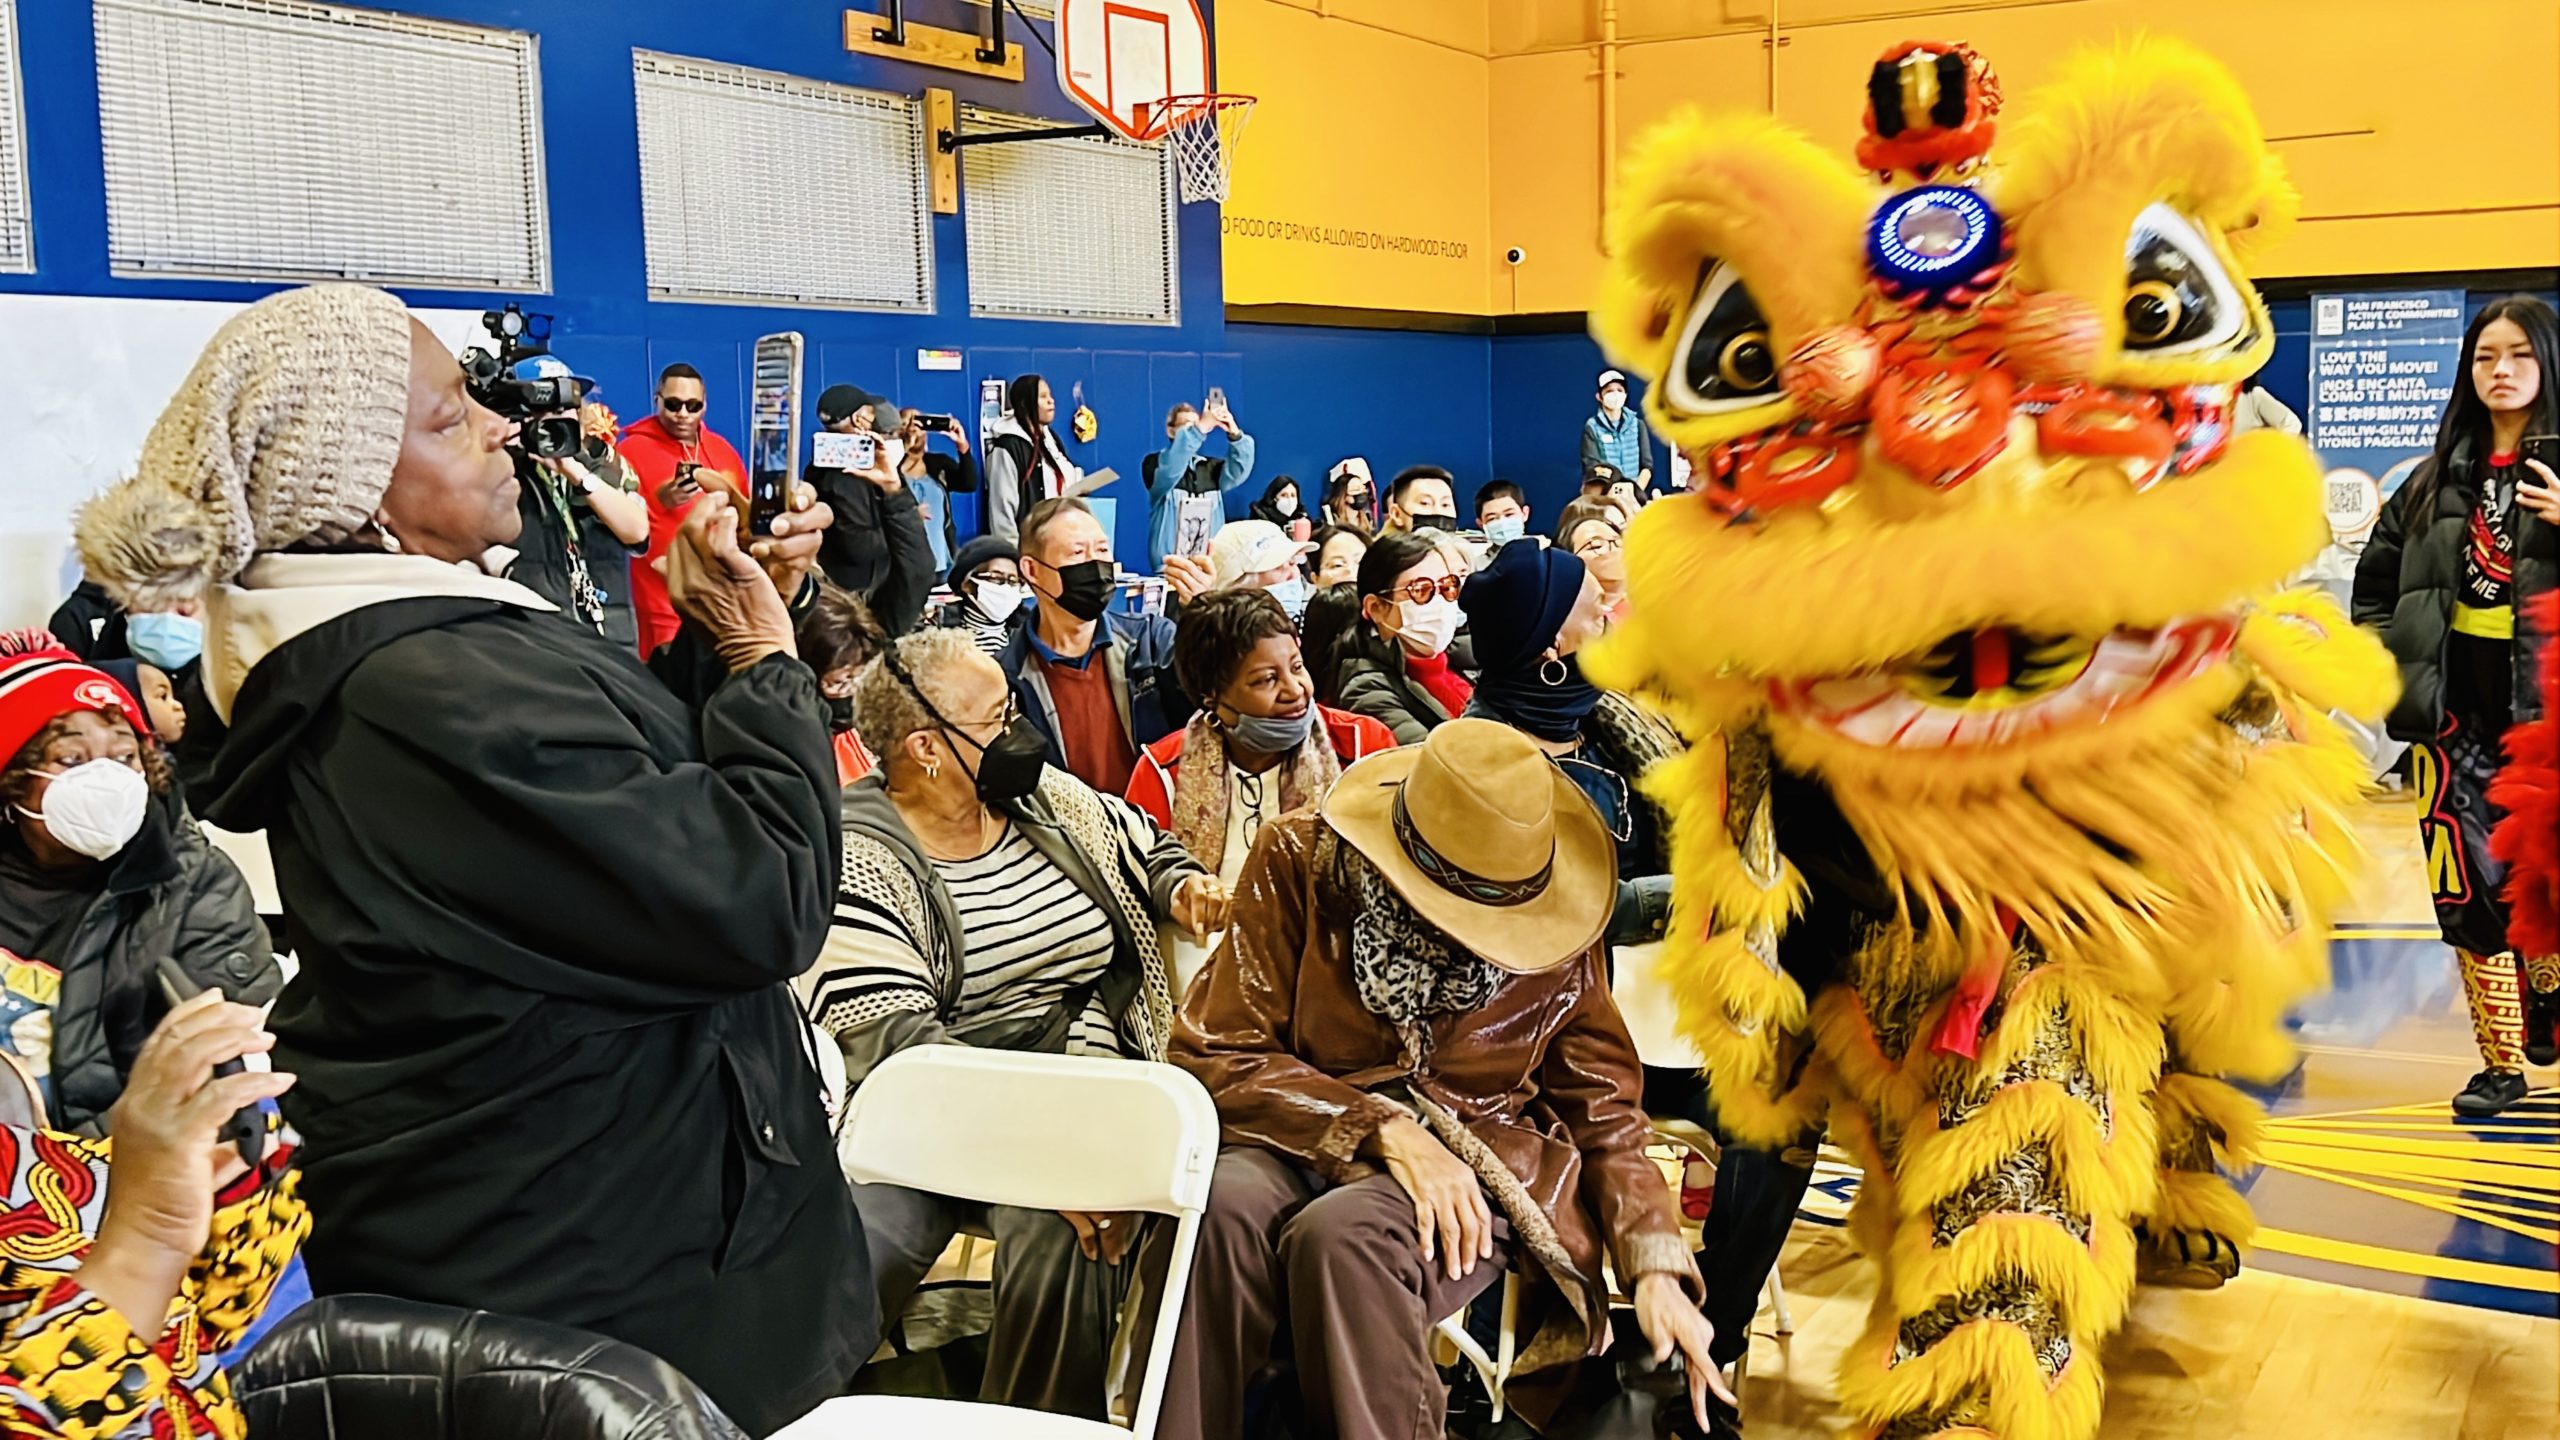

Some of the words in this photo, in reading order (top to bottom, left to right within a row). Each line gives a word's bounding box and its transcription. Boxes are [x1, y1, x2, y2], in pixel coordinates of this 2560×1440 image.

[1220, 216, 1230, 234] O
[1233, 217, 1264, 237] FOOD
[1267, 221, 1282, 239] OR
[1285, 223, 1320, 243] DRINKS
[1324, 228, 1369, 249] ALLOWED
[1370, 233, 1385, 250] ON
[1387, 235, 1439, 255] HARDWOOD
[1441, 241, 1468, 259] FLOOR
[2347, 301, 2370, 312] SAN
[2370, 299, 2430, 310] FRANCISCO
[2347, 311, 2384, 321] ACTIVE
[2385, 308, 2460, 320] COMMUNITIES
[2347, 321, 2374, 331] PLAN
[2319, 352, 2357, 364] LOVE
[2359, 350, 2387, 363] THE
[2319, 364, 2352, 376] WAY
[2355, 362, 2386, 375] YOU
[2389, 361, 2438, 374] MOVE!
[2357, 377, 2427, 390] ENCANTA
[2319, 390, 2365, 402] COMO
[2367, 390, 2385, 401] TE
[2318, 424, 2419, 437] KAGILIW-GILIW
[2318, 436, 2361, 448] IYONG
